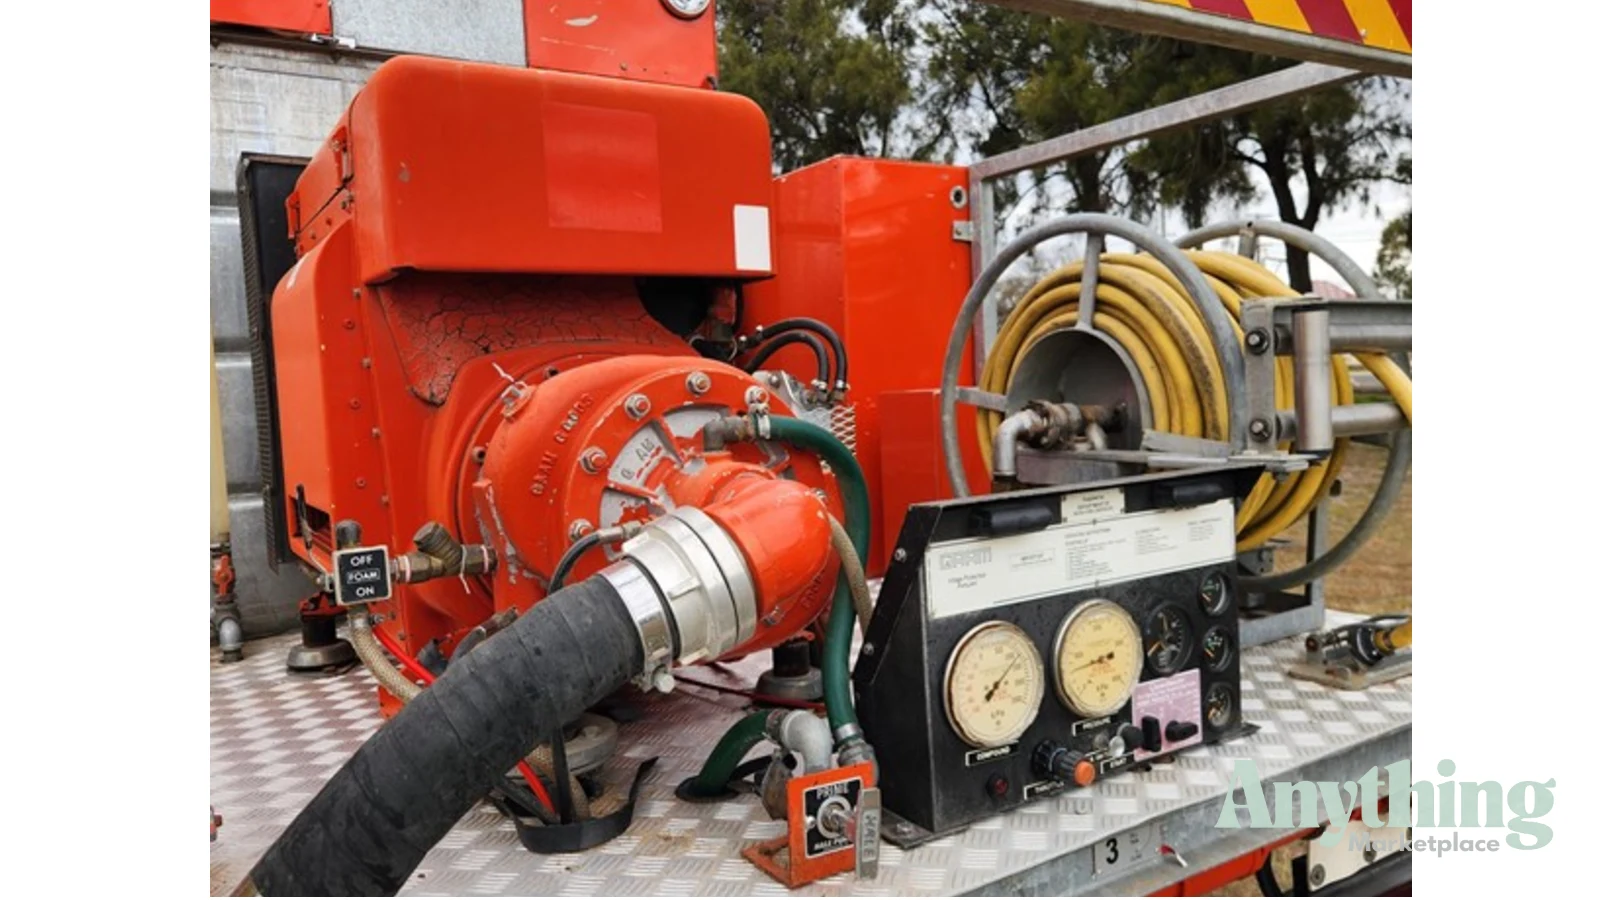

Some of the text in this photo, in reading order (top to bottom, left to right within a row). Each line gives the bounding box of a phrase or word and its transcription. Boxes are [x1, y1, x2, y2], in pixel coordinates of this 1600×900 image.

[350, 554, 373, 567] OFF
[347, 571, 377, 582] FOAM
[355, 586, 375, 598] ON
[1105, 837, 1119, 865] 3
